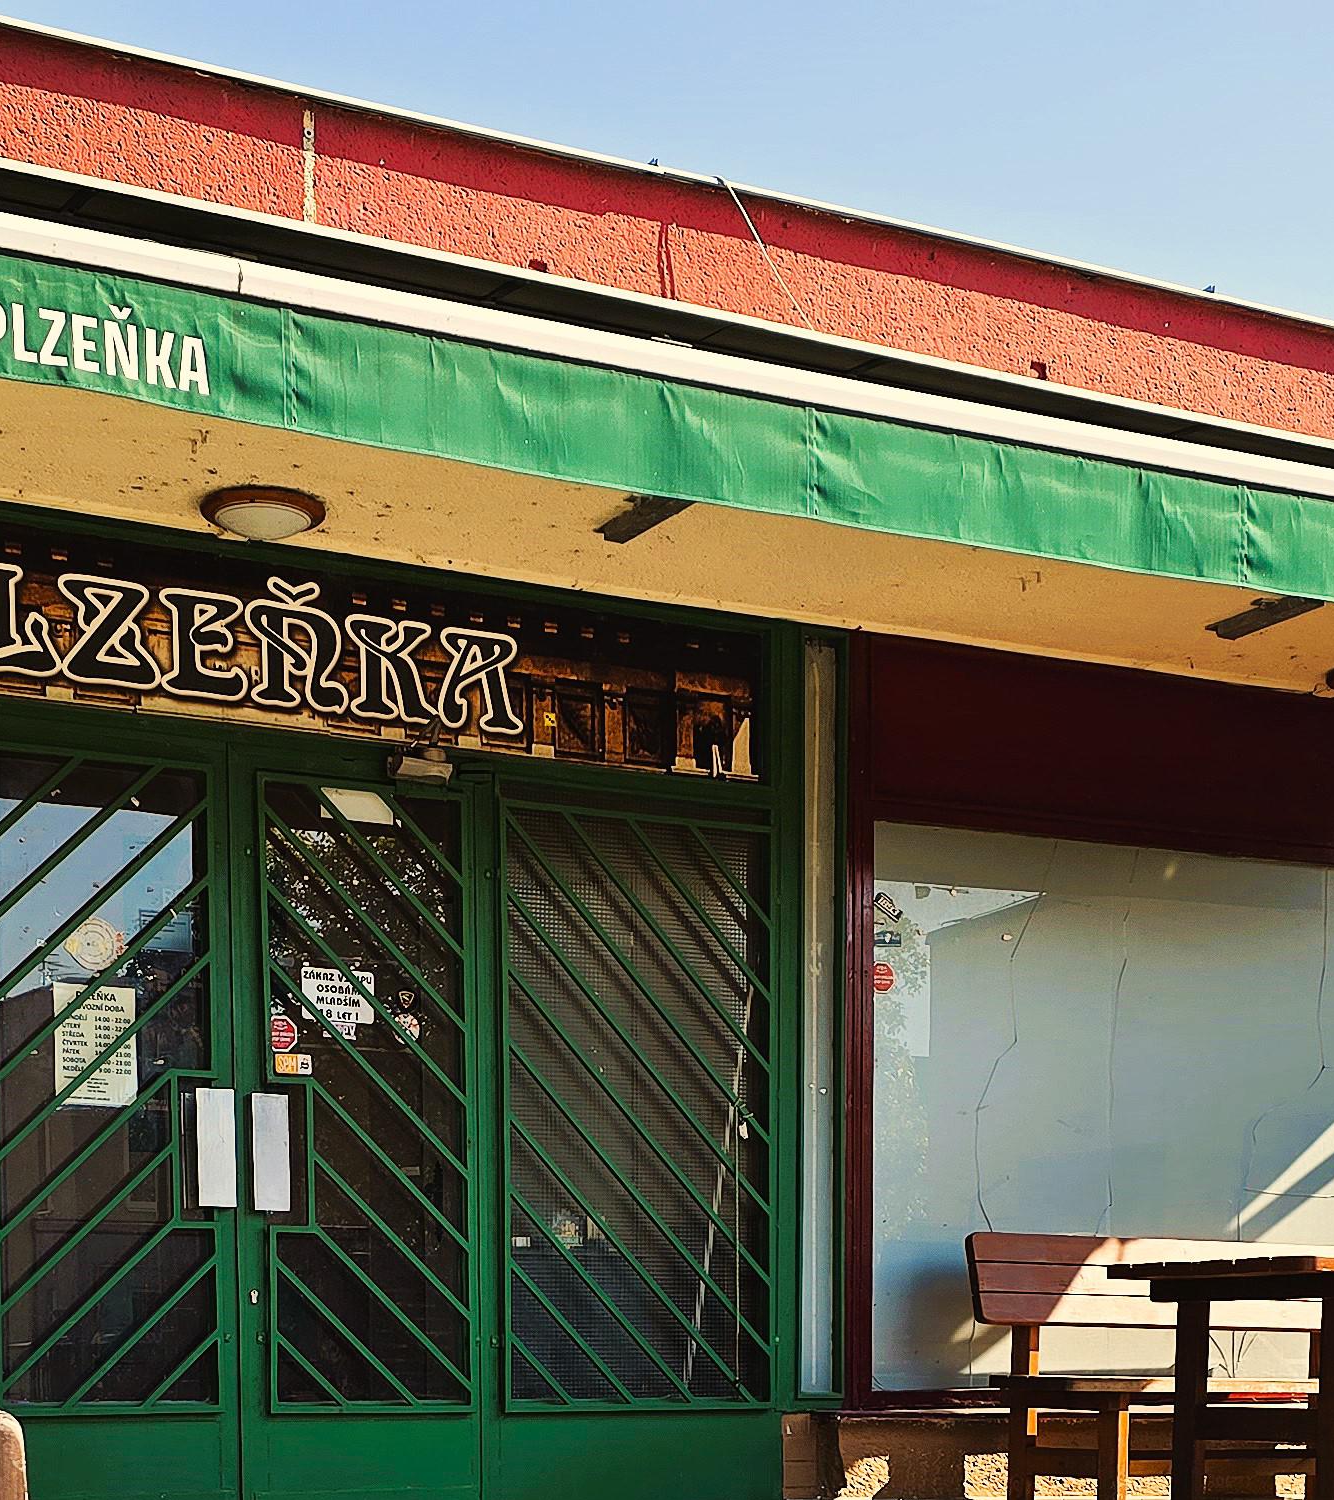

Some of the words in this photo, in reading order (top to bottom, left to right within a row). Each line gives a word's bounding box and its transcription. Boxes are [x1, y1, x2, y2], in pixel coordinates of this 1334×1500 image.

[303, 970, 335, 982] ZÁKAZ
[316, 995, 360, 1008] MLADŠÍM
[337, 1011, 352, 1021] LET
